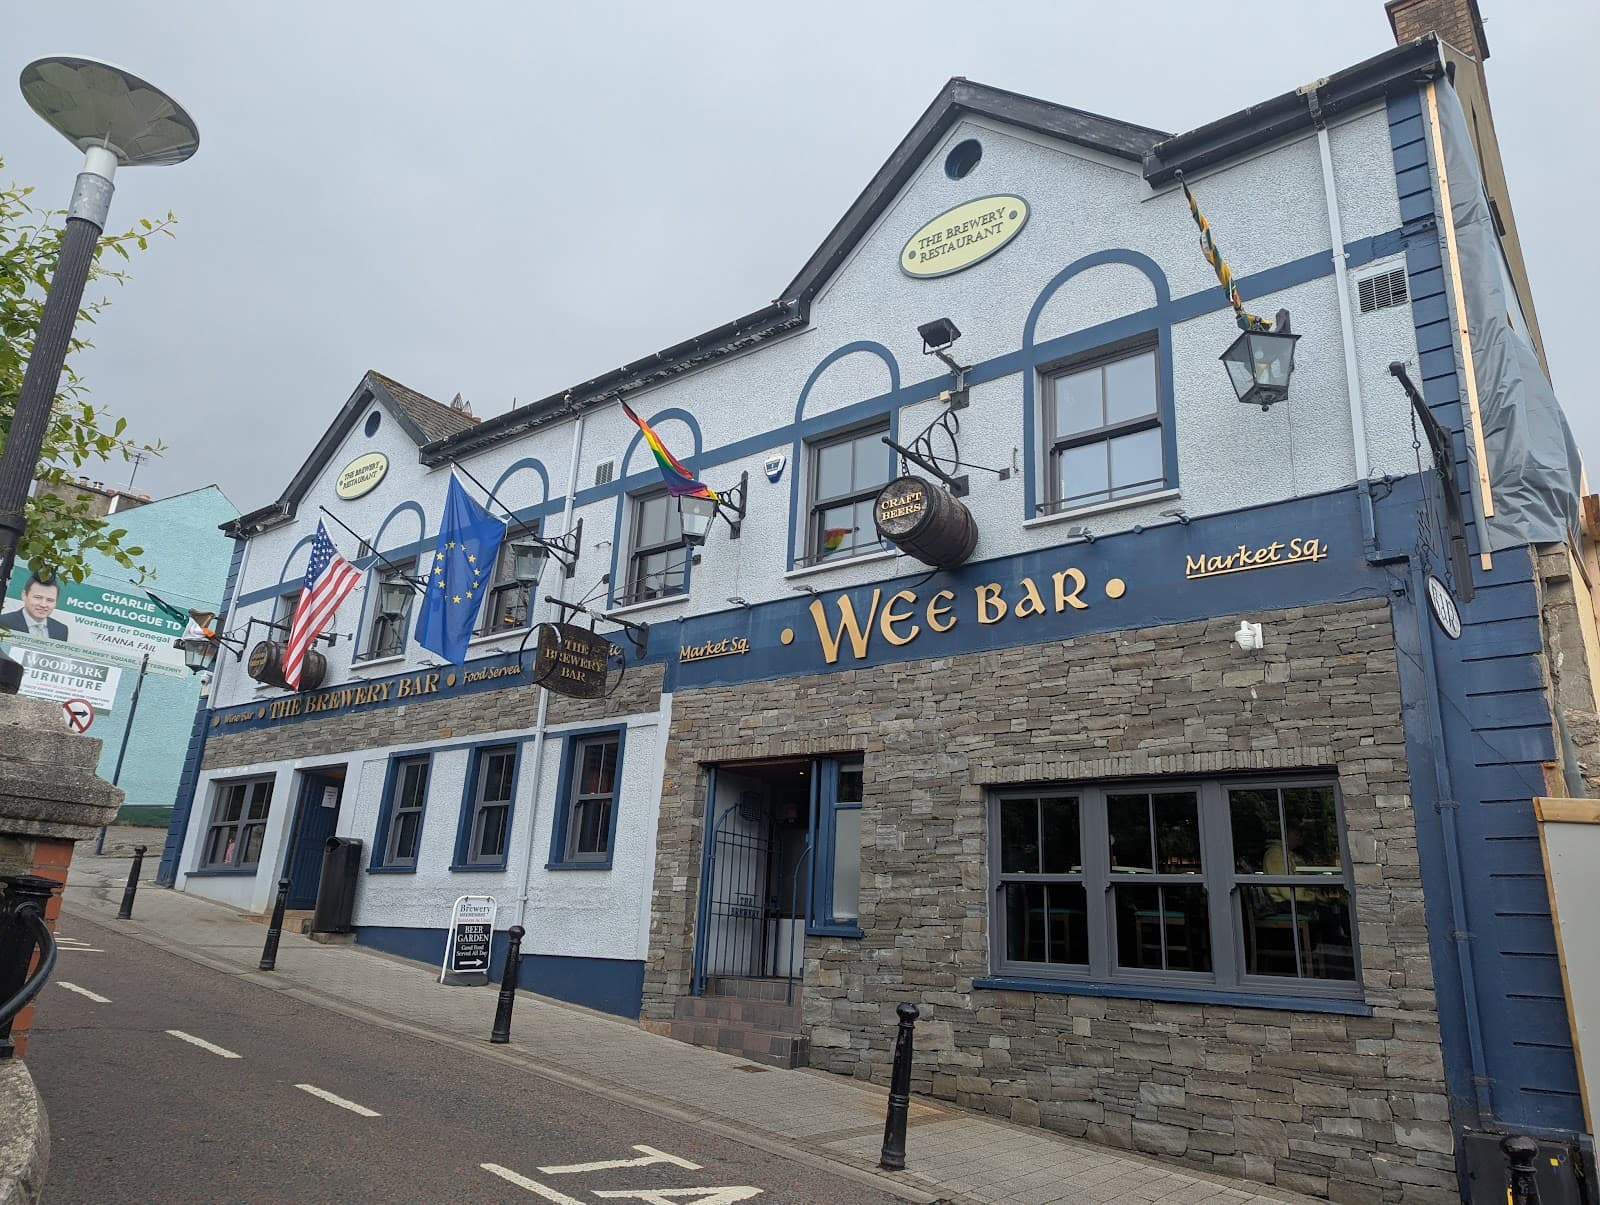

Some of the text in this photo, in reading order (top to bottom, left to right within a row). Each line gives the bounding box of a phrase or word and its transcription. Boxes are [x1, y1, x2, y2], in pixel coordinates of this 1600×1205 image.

[918, 207, 1006, 250] THE BREWERY
[919, 222, 1004, 263] RESTAURANT
[343, 470, 378, 489] RESTAURANT
[881, 491, 922, 510] CRAFT
[881, 503, 921, 521] BEERS
[1186, 537, 1328, 575] Market Sq.
[101, 592, 157, 613] CHARLIE
[66, 596, 182, 632] McCONALOGUE TD
[74, 616, 170, 644] Working for Donegal
[96, 633, 134, 648] FIANNA
[564, 639, 589, 654] THE
[680, 637, 749, 660] Market Sq.
[26, 654, 105, 679] WOODPARK
[463, 667, 488, 685] Food
[560, 667, 587, 682] BAR
[269, 673, 441, 720] THE BREWERY BAR
[461, 904, 490, 914] Brewery
[457, 933, 489, 942] GARDEN
[465, 925, 484, 933] BEER
